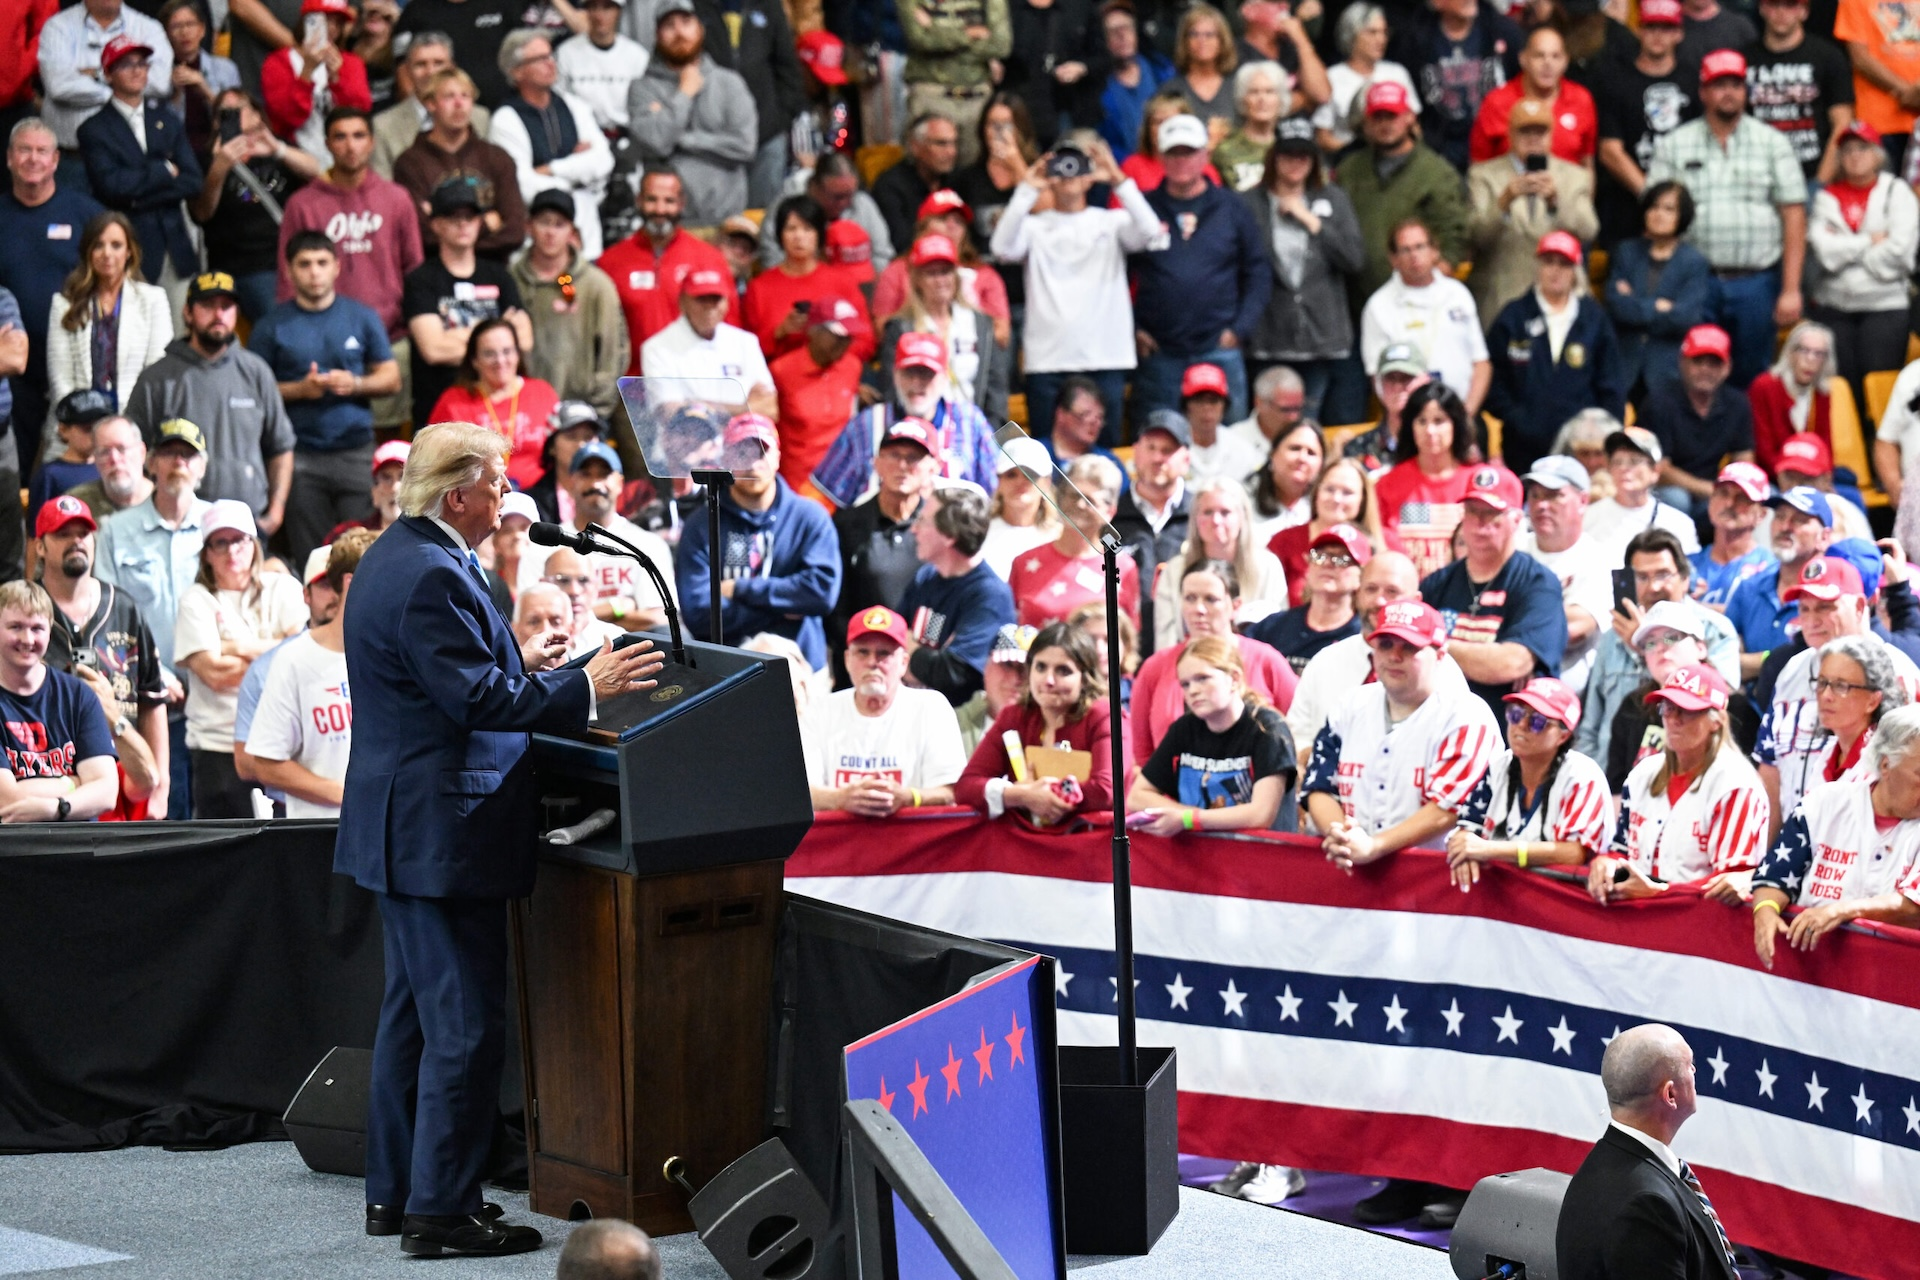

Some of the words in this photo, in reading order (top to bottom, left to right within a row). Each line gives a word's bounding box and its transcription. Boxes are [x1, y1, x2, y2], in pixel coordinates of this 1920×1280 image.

[6, 741, 76, 777] LYERS
[840, 755, 876, 768] COUNT
[880, 756, 897, 768] ALL
[1817, 843, 1858, 865] FRONT
[1814, 864, 1846, 881] ROW
[1809, 882, 1843, 900] JOES
